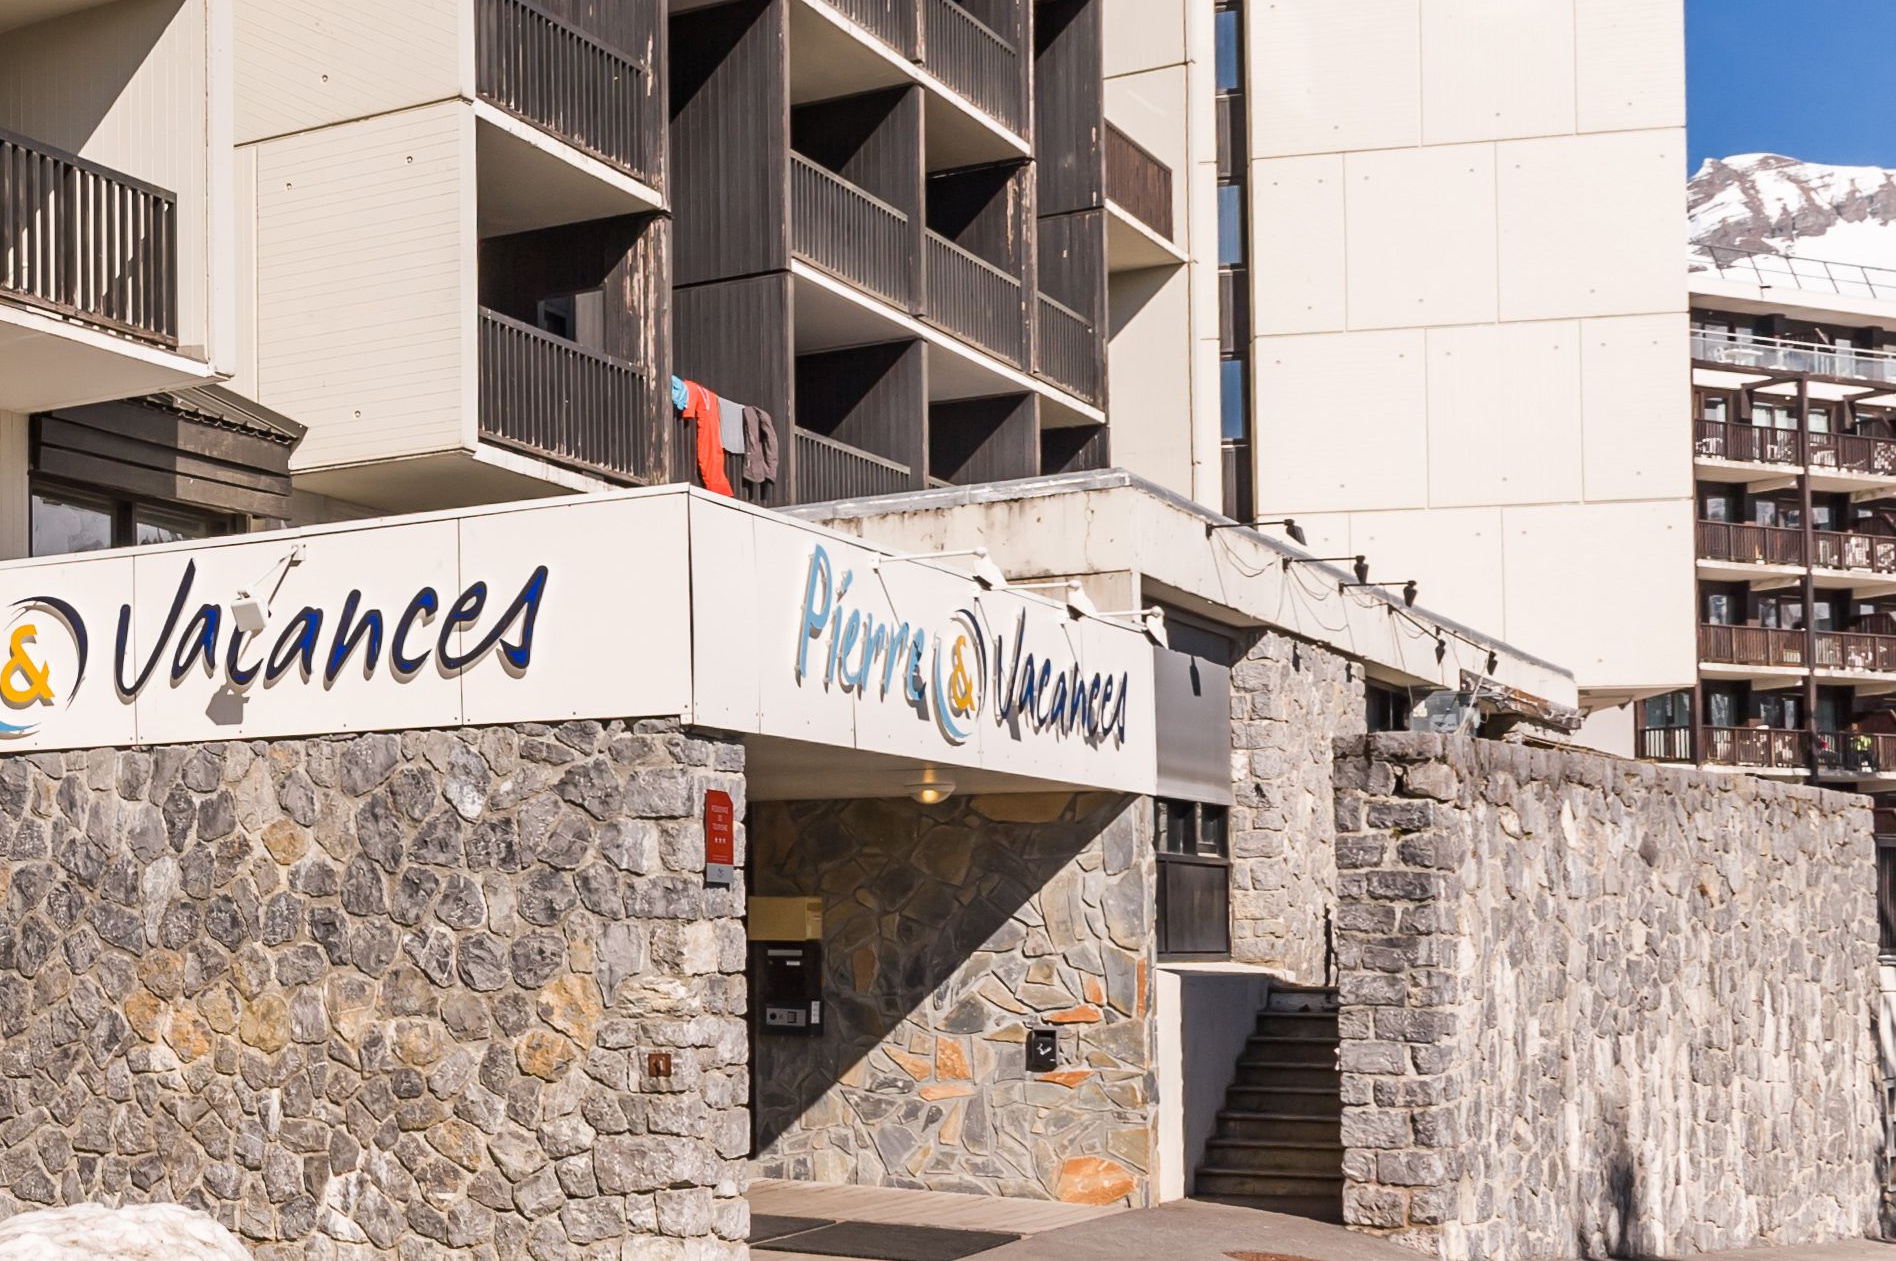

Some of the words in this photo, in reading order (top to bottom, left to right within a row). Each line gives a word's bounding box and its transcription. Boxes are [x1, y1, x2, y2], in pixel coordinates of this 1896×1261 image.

[0, 623, 56, 704] &
[114, 558, 549, 696] Vacances
[798, 543, 925, 701] Pierre
[953, 634, 976, 712] &
[997, 606, 1128, 745] Vacances
